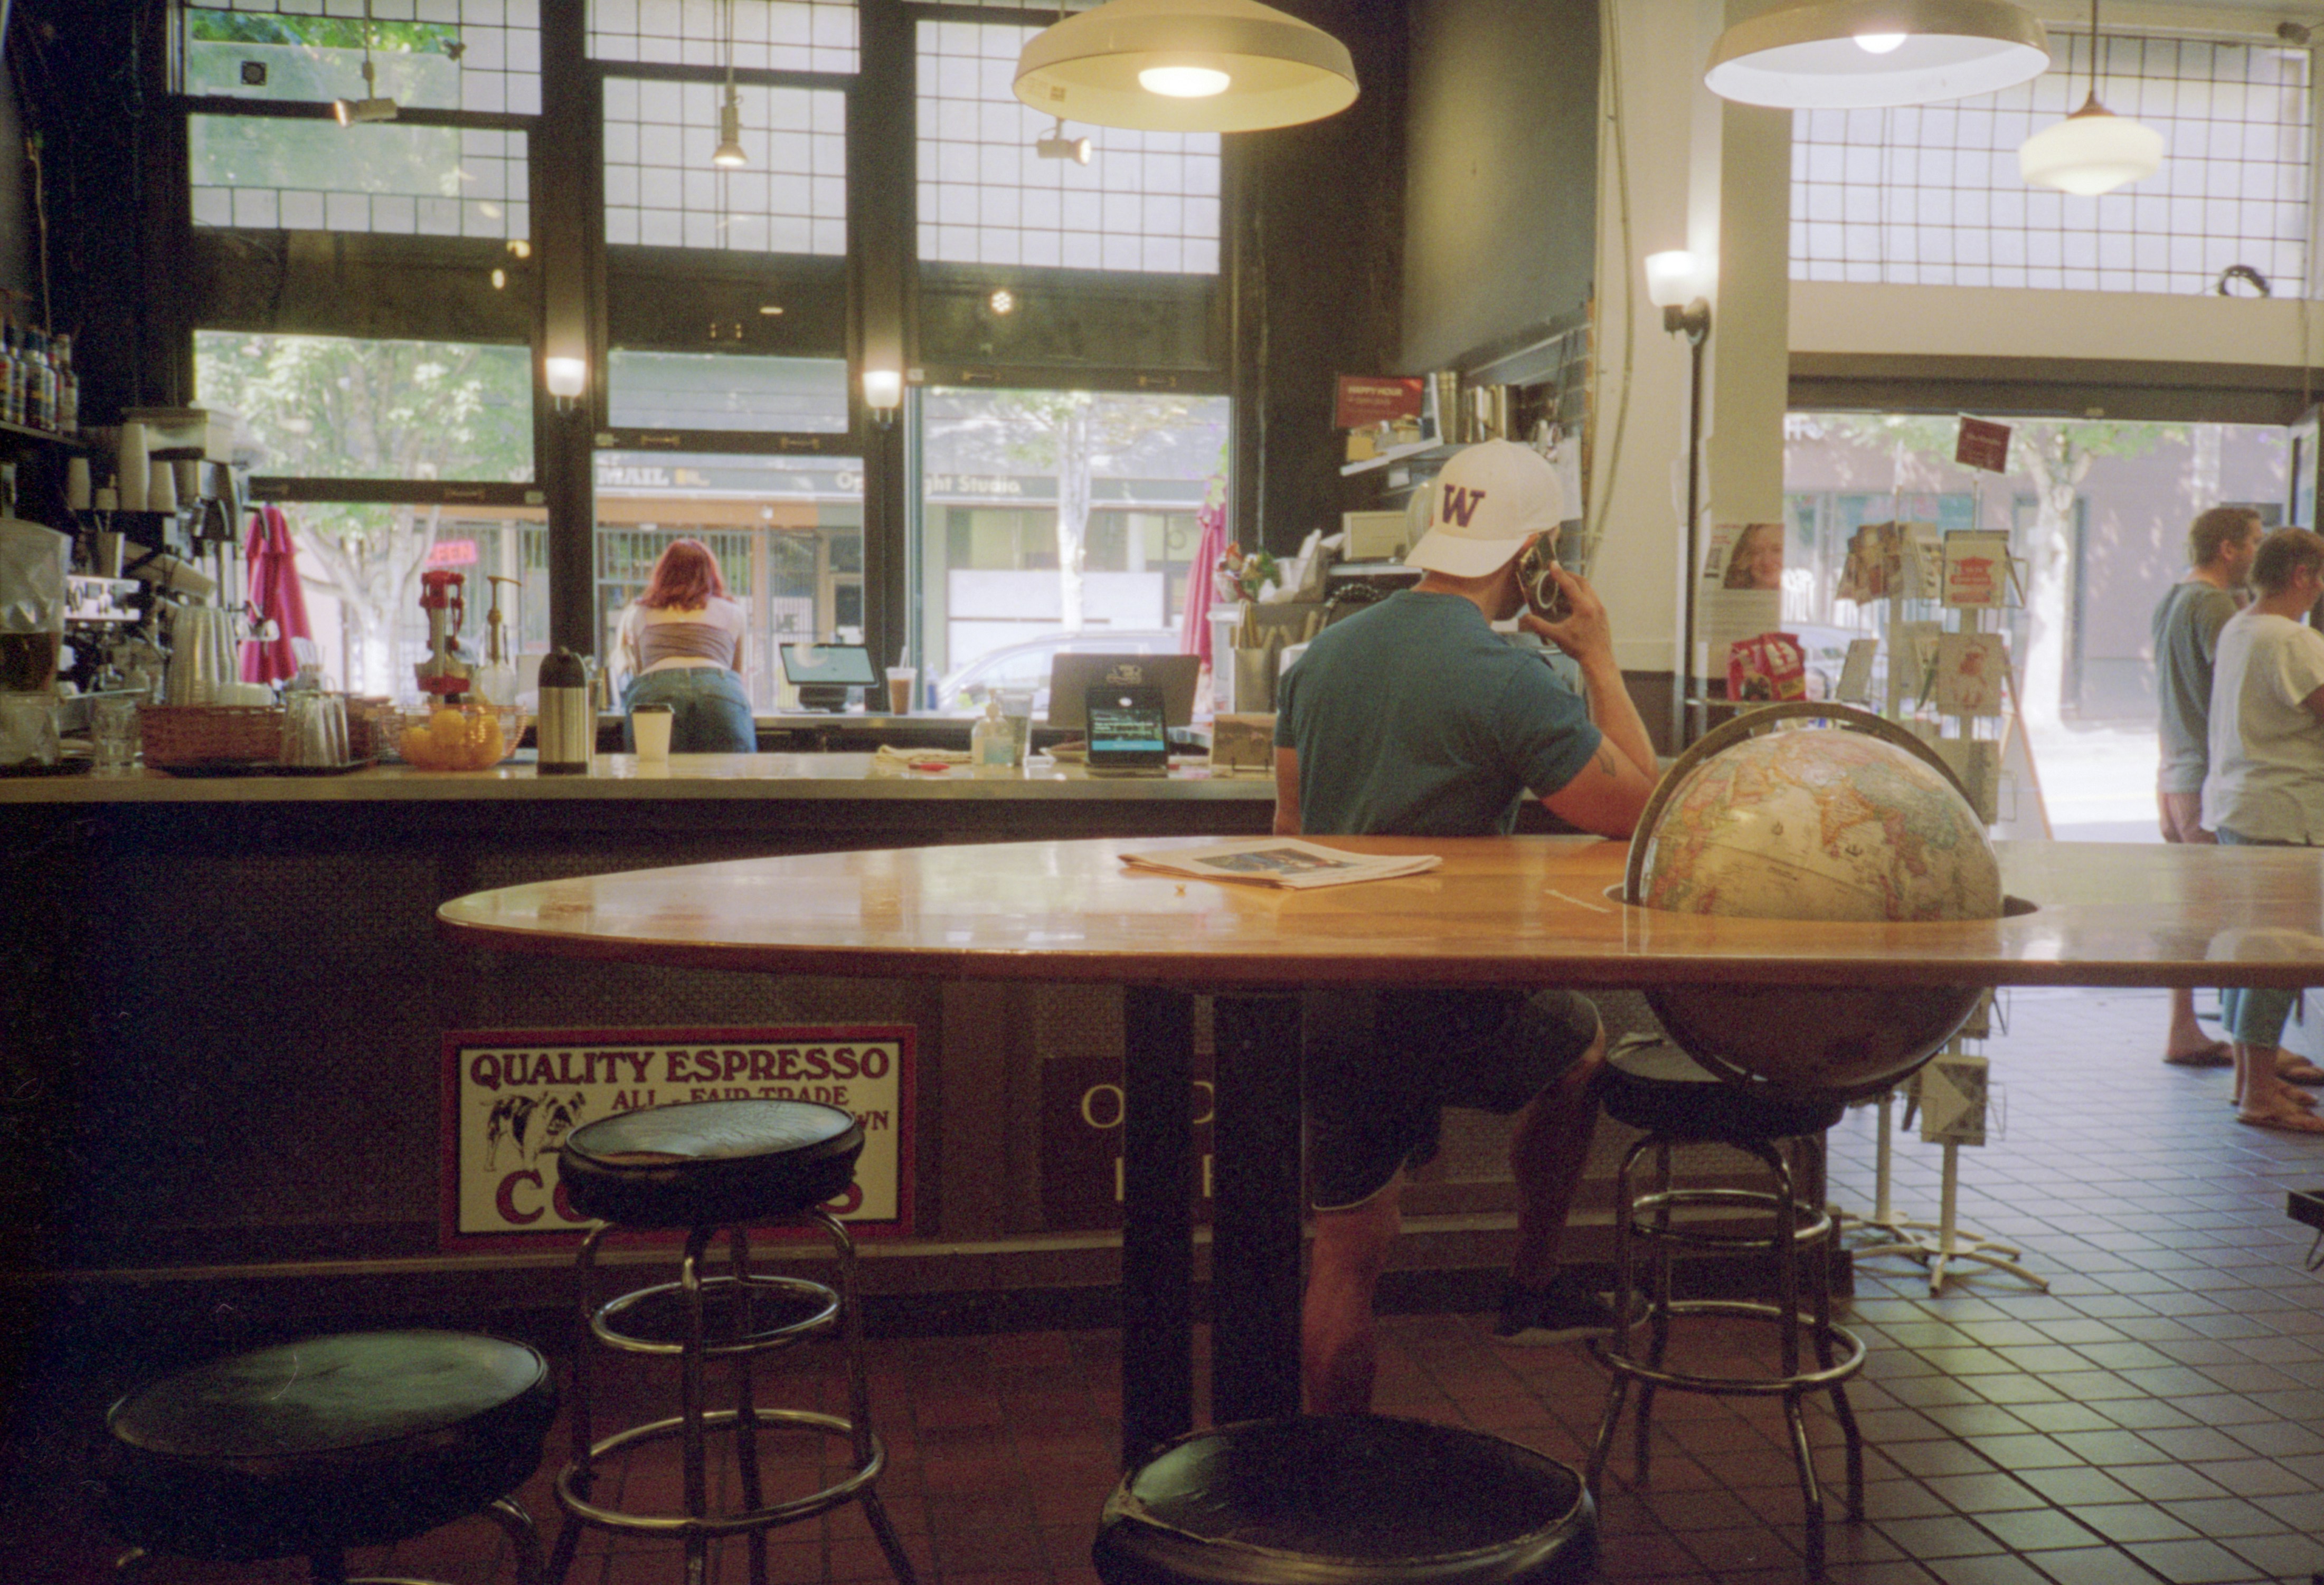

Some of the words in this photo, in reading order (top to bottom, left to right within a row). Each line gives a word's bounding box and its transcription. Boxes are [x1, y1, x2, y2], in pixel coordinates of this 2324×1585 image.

[957, 474, 1021, 493] Studio
[1442, 483, 1486, 527] W
[470, 1051, 656, 1091] QUALITY
[665, 1047, 889, 1083] ESPRESSO
